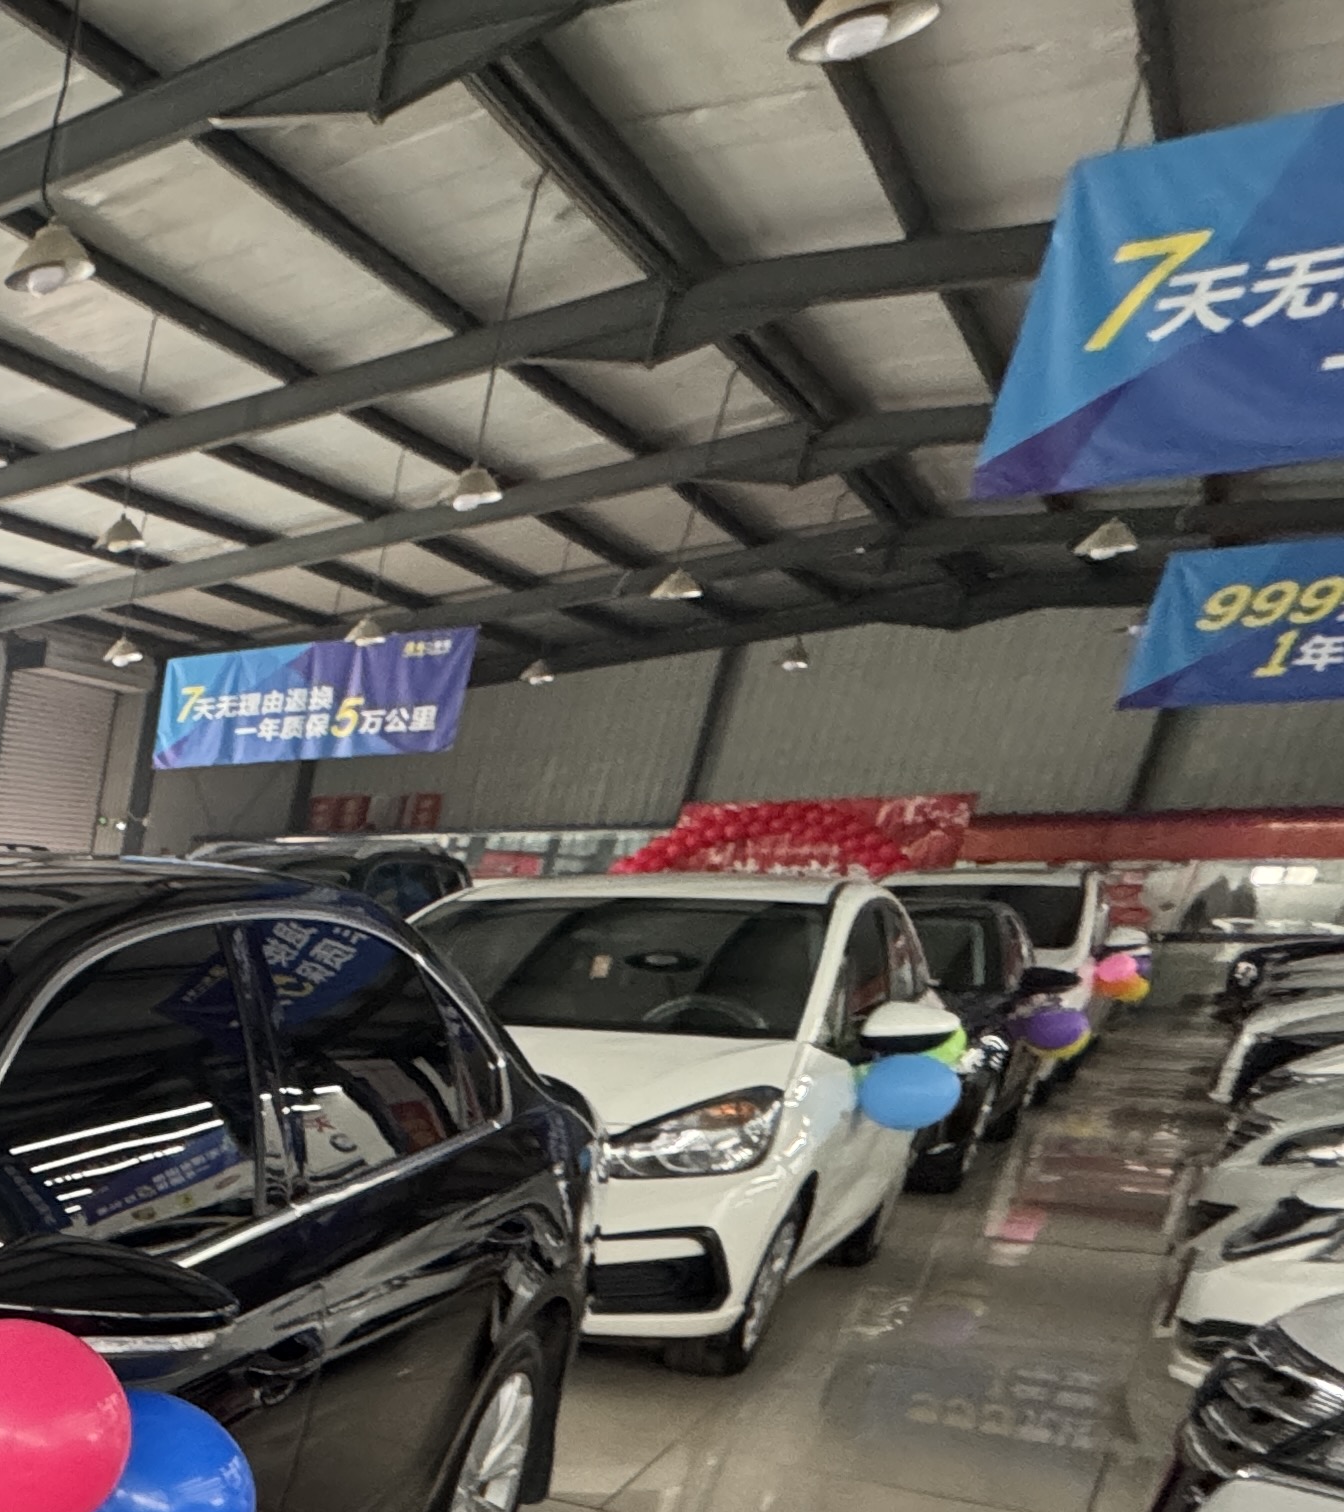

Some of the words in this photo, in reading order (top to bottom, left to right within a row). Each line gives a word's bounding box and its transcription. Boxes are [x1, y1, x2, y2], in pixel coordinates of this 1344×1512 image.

[1084, 228, 1344, 352] 7天无
[1195, 576, 1344, 631] 999
[1251, 629, 1344, 678] 1年
[177, 685, 334, 723] 7天无理由退换
[234, 697, 438, 742] 一年质保5万公里
